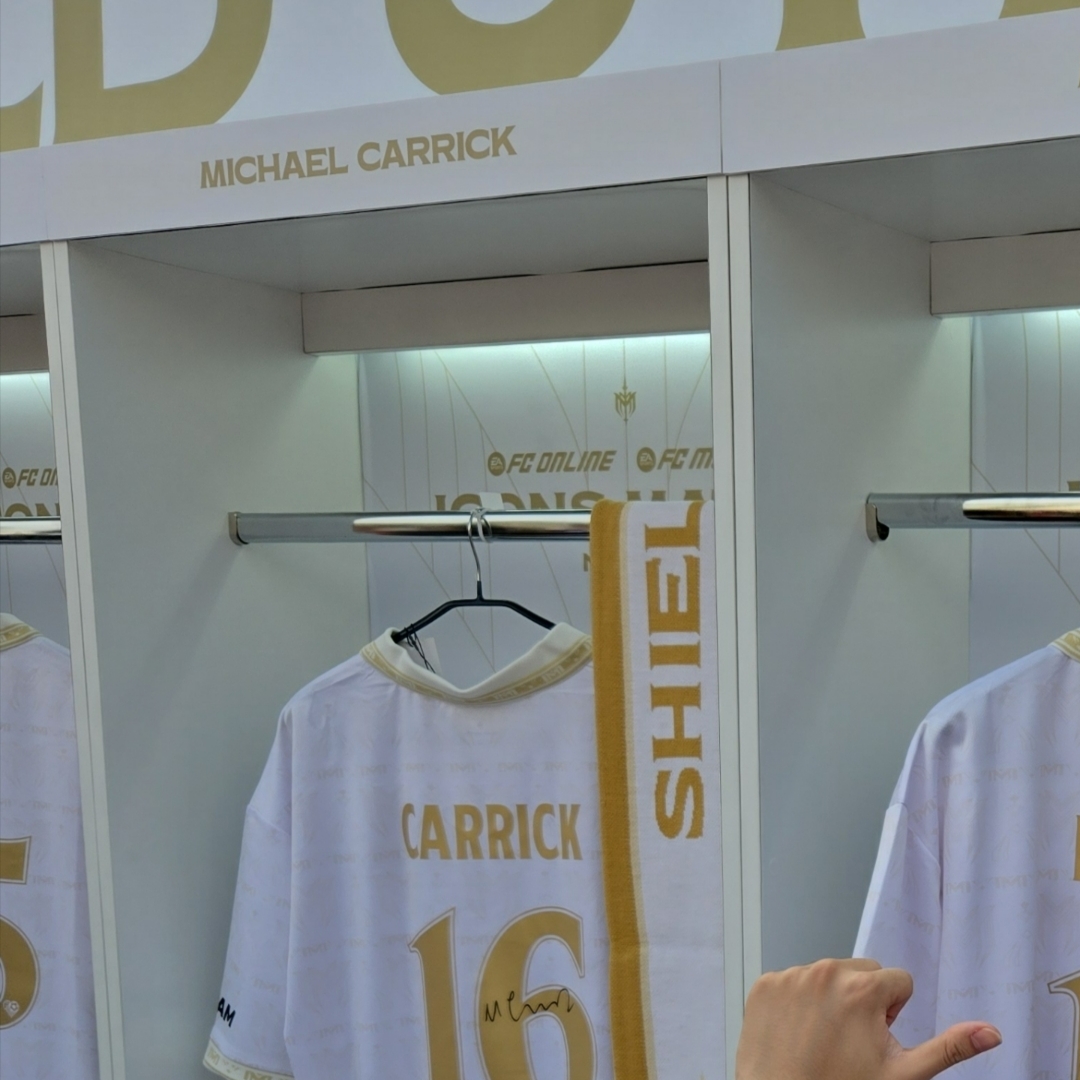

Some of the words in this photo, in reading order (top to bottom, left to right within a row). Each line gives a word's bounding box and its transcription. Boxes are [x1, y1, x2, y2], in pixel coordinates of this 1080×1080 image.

[201, 146, 348, 189] MICHAEL
[357, 125, 517, 172] CARRICK
[506, 453, 537, 473] FC
[536, 450, 617, 473] ONLINE
[657, 448, 690, 470] FC
[17, 469, 39, 486] FC
[402, 802, 583, 861] CARRICK
